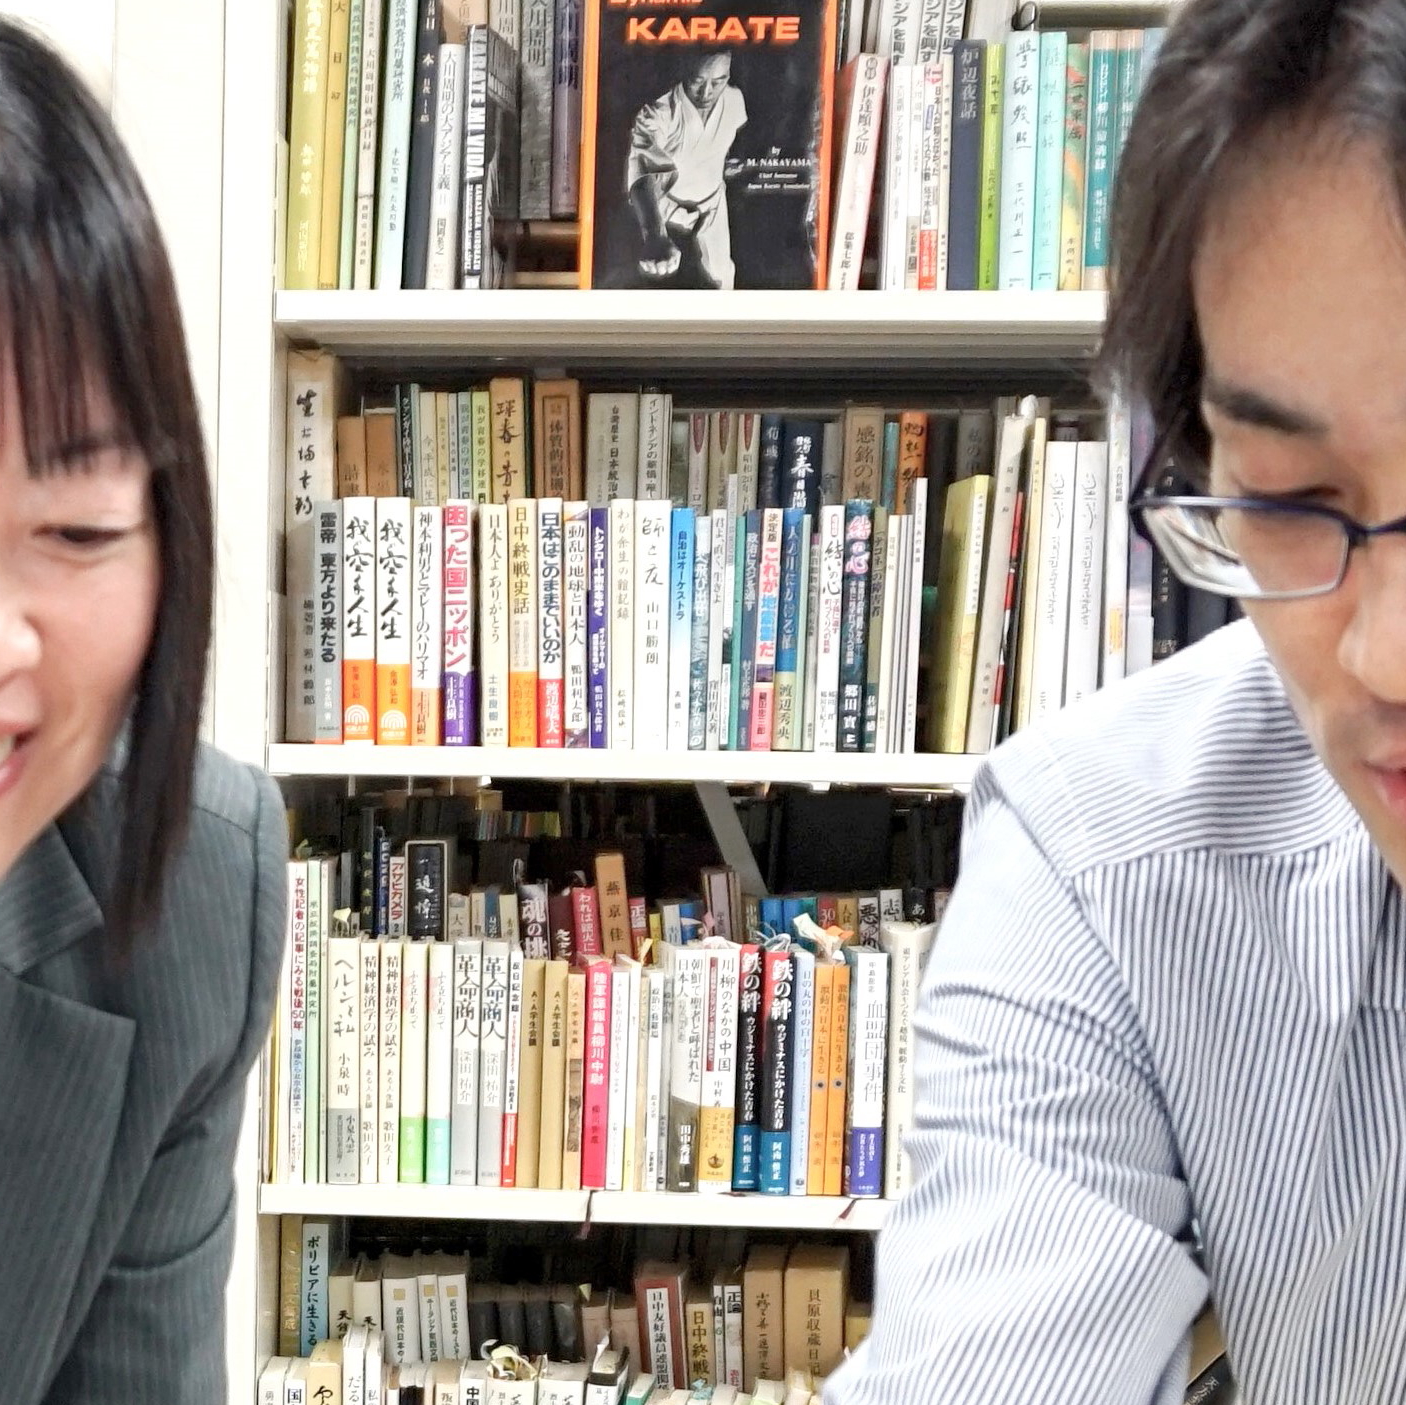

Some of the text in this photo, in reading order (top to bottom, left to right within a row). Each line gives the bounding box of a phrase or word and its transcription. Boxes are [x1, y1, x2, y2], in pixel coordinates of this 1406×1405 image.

[629, 16, 801, 41] KARATE
[854, 86, 876, 156] 伊達順之助
[961, 48, 979, 119] 炉辺夜話
[760, 158, 812, 168] NAKAYAMA
[513, 508, 530, 613] 日中終戦史話
[768, 512, 778, 544] 決定版
[320, 512, 337, 662] 雷帝 東方より来たる
[446, 506, 468, 668] 困った国ニッポン
[542, 513, 561, 664] 日本はこのままでいいのか
[567, 525, 586, 646] 動乱の地球と日本人
[676, 531, 688, 622] 自治はオーケストラ
[606, 880, 624, 957] 燕京佳
[363, 956, 377, 1058] 精神経済学の試み
[386, 956, 399, 1058] 精神経済学の試み
[456, 954, 478, 1038] 革命商人
[483, 956, 506, 1040] 革命商人
[717, 957, 737, 1073] 川柳のなかの中国
[740, 952, 762, 1013] 鉄の絆
[770, 959, 793, 1020] 鉄の絆
[862, 1000, 884, 1103] 血盟団事件
[307, 1236, 320, 1346] ボリビアに生きる
[806, 1289, 822, 1376] 貝原収蔵日記
